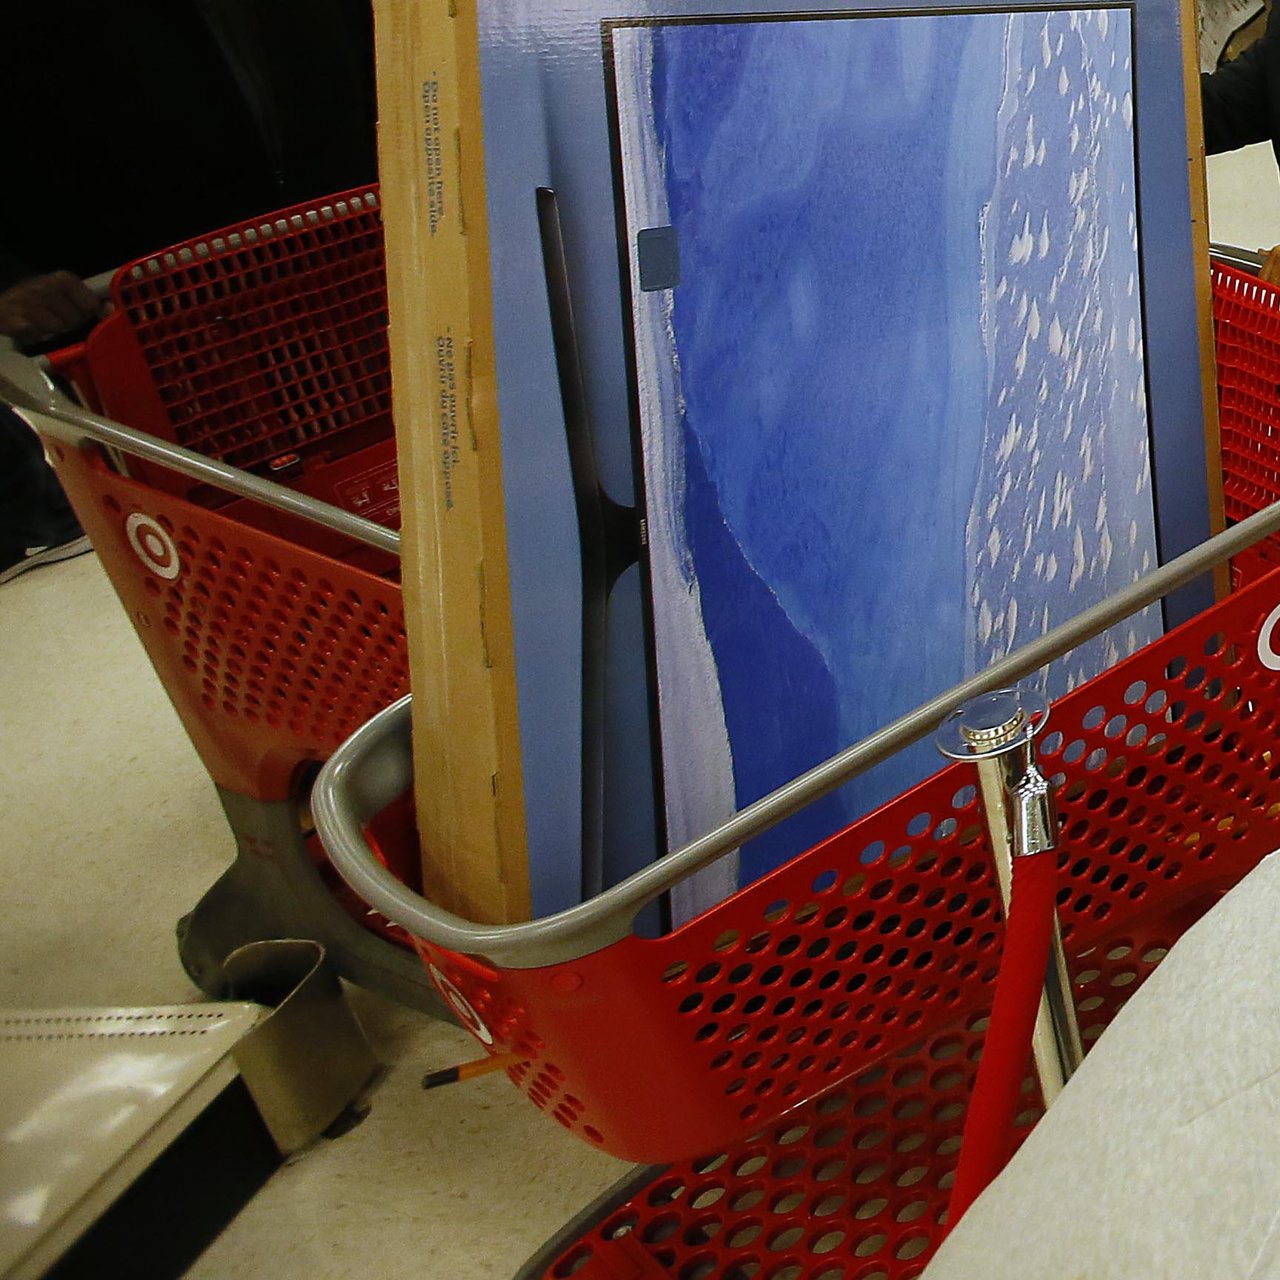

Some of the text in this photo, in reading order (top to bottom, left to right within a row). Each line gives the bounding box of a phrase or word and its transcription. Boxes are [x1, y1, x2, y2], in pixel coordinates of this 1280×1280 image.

[432, 106, 441, 133] not
[446, 337, 455, 359] Ne
[447, 362, 457, 390] pas
